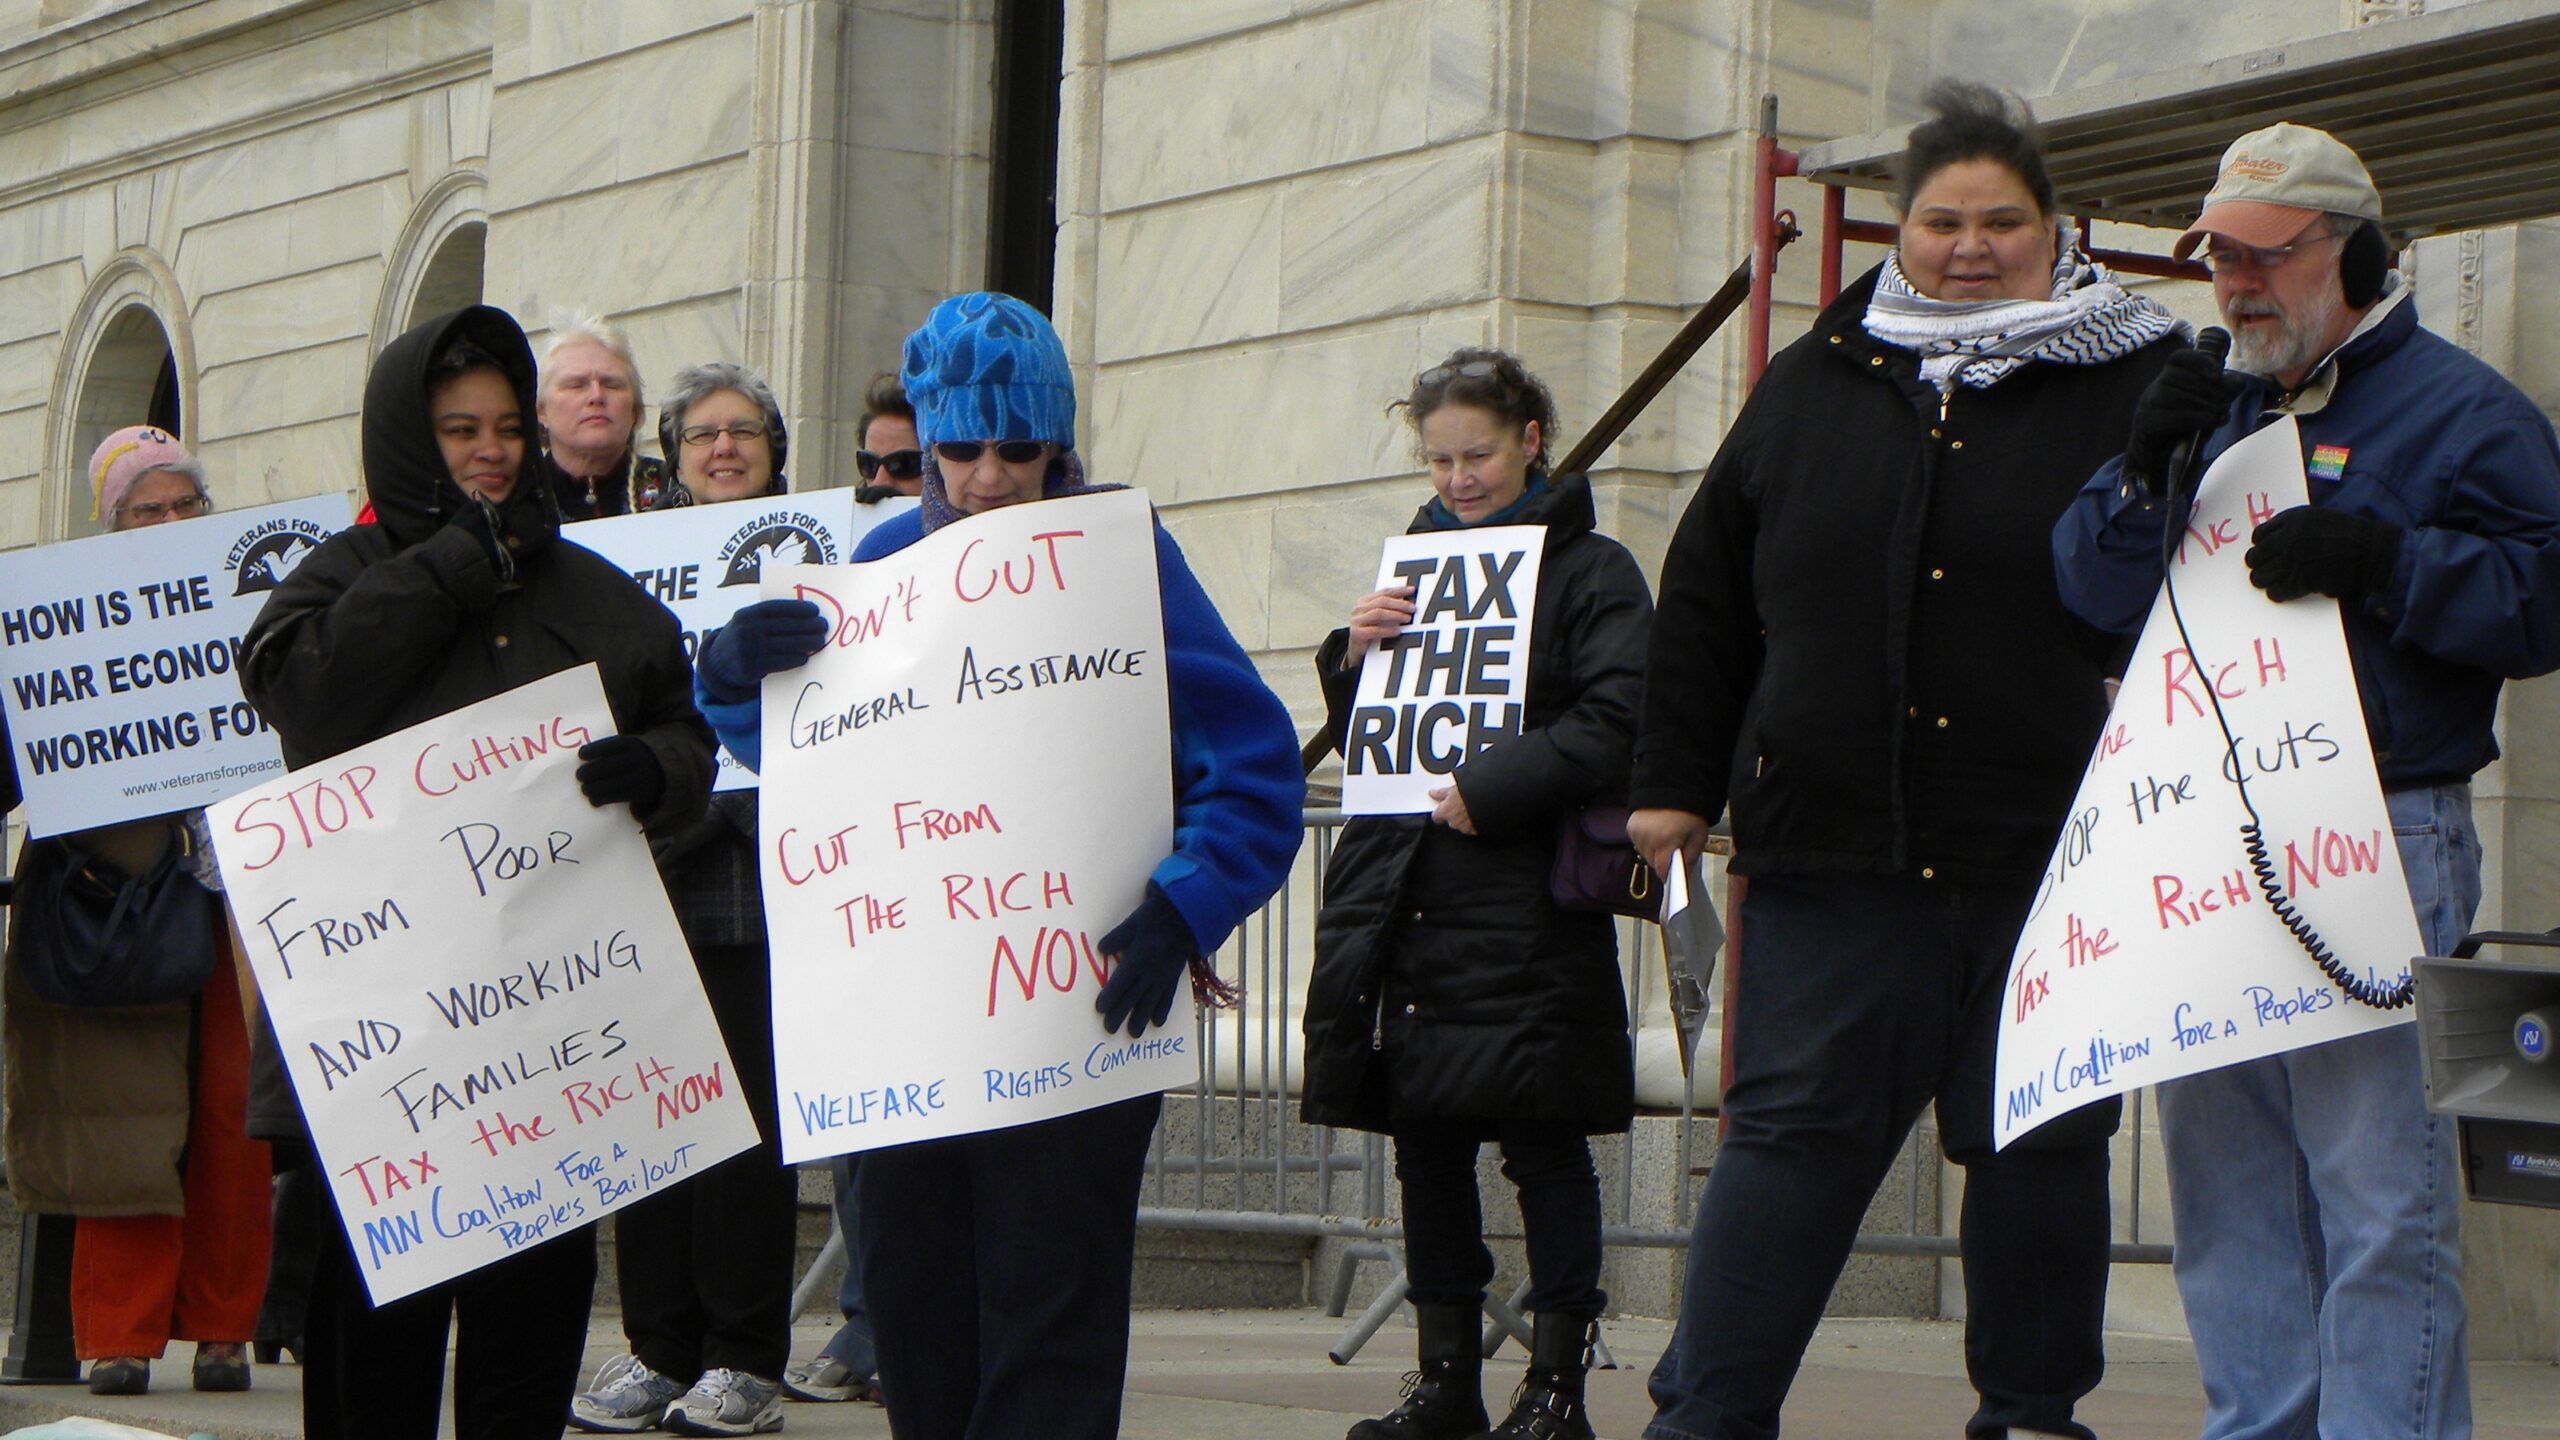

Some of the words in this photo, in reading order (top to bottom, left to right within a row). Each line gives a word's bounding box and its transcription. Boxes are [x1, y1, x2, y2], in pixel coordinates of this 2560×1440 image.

[224, 519, 287, 571] VETERANS
[292, 519, 320, 537] FOR
[716, 511, 788, 561] VETERANS
[791, 512, 818, 531] FOR
[815, 526, 838, 565] PEAC
[955, 530, 1084, 603] CUT
[2, 598, 85, 646] HOW
[96, 589, 132, 629] IS
[139, 575, 214, 620] THE
[633, 564, 699, 602] THE
[1394, 551, 1526, 624] TAX
[13, 664, 99, 711] WAR
[791, 682, 929, 749] GENERAL
[957, 646, 1147, 704] ASSISTANCE
[1380, 625, 1515, 698] THE
[26, 711, 201, 776] WORKING
[209, 701, 269, 742] FO
[1347, 701, 1522, 775] RICH
[235, 765, 376, 870] STOP
[2127, 775, 2197, 825] the
[778, 825, 858, 886] CUT
[893, 800, 1002, 850] FROM
[258, 898, 410, 980] FROM
[441, 823, 580, 896] POOR
[834, 894, 907, 948] THE
[942, 871, 1074, 920] RICH
[2060, 912, 2120, 970] the
[2284, 825, 2382, 900] NOW
[309, 1020, 402, 1090] AND
[427, 929, 642, 1029] WORKING
[381, 1020, 627, 1133] FAMILIES
[2006, 1071, 2044, 1132] MN
[2223, 1019, 2239, 1037] A
[2242, 986, 2334, 1028] People's
[340, 1151, 440, 1207] TAX
[470, 1112, 556, 1156] the
[562, 1056, 675, 1124] RICH
[656, 1062, 724, 1129] NOW
[794, 1079, 946, 1136] WELFARE
[983, 1062, 1073, 1103] RIGHTS
[363, 1210, 424, 1270] MN
[613, 1142, 628, 1162] A
[488, 1197, 585, 1249] People's
